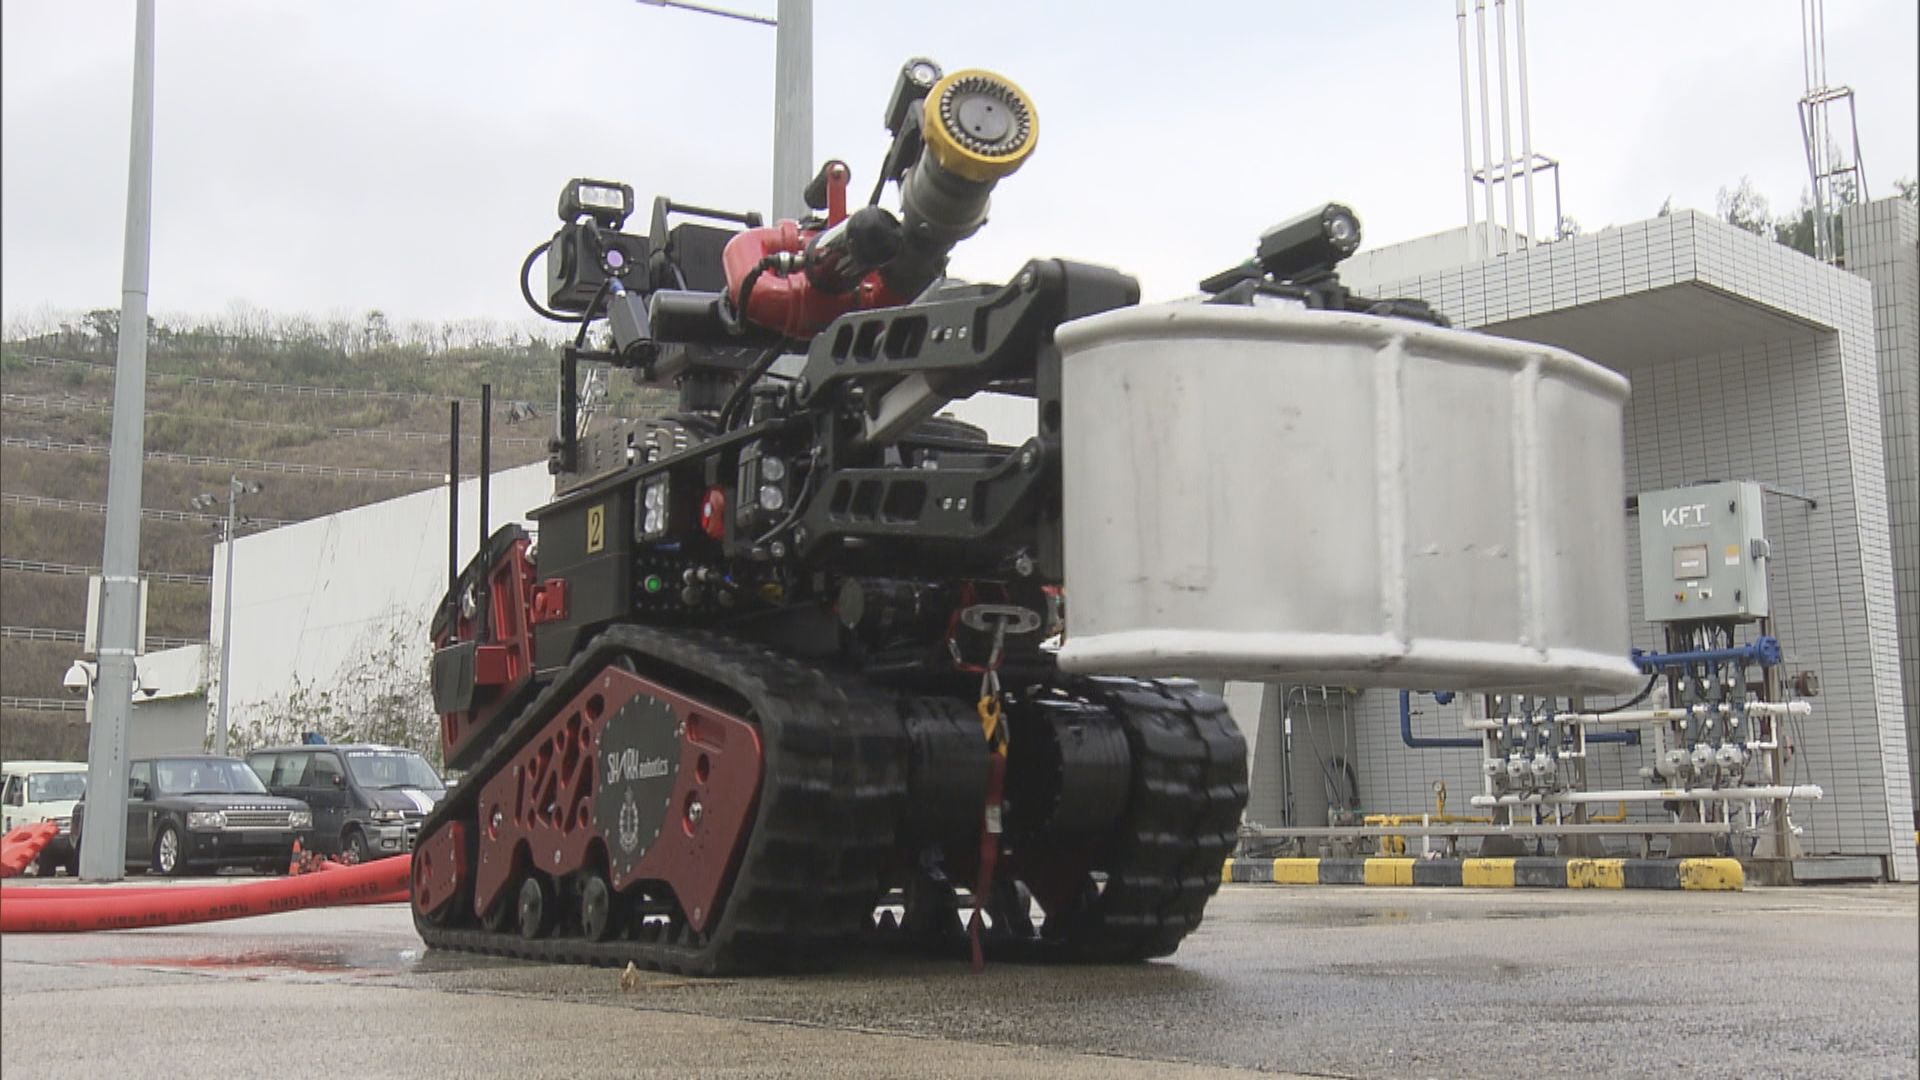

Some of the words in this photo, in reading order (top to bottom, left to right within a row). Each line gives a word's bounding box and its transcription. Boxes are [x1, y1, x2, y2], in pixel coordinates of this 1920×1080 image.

[591, 511, 601, 547] 2
[1661, 503, 1706, 528] KFT
[607, 747, 640, 785] SHARK
